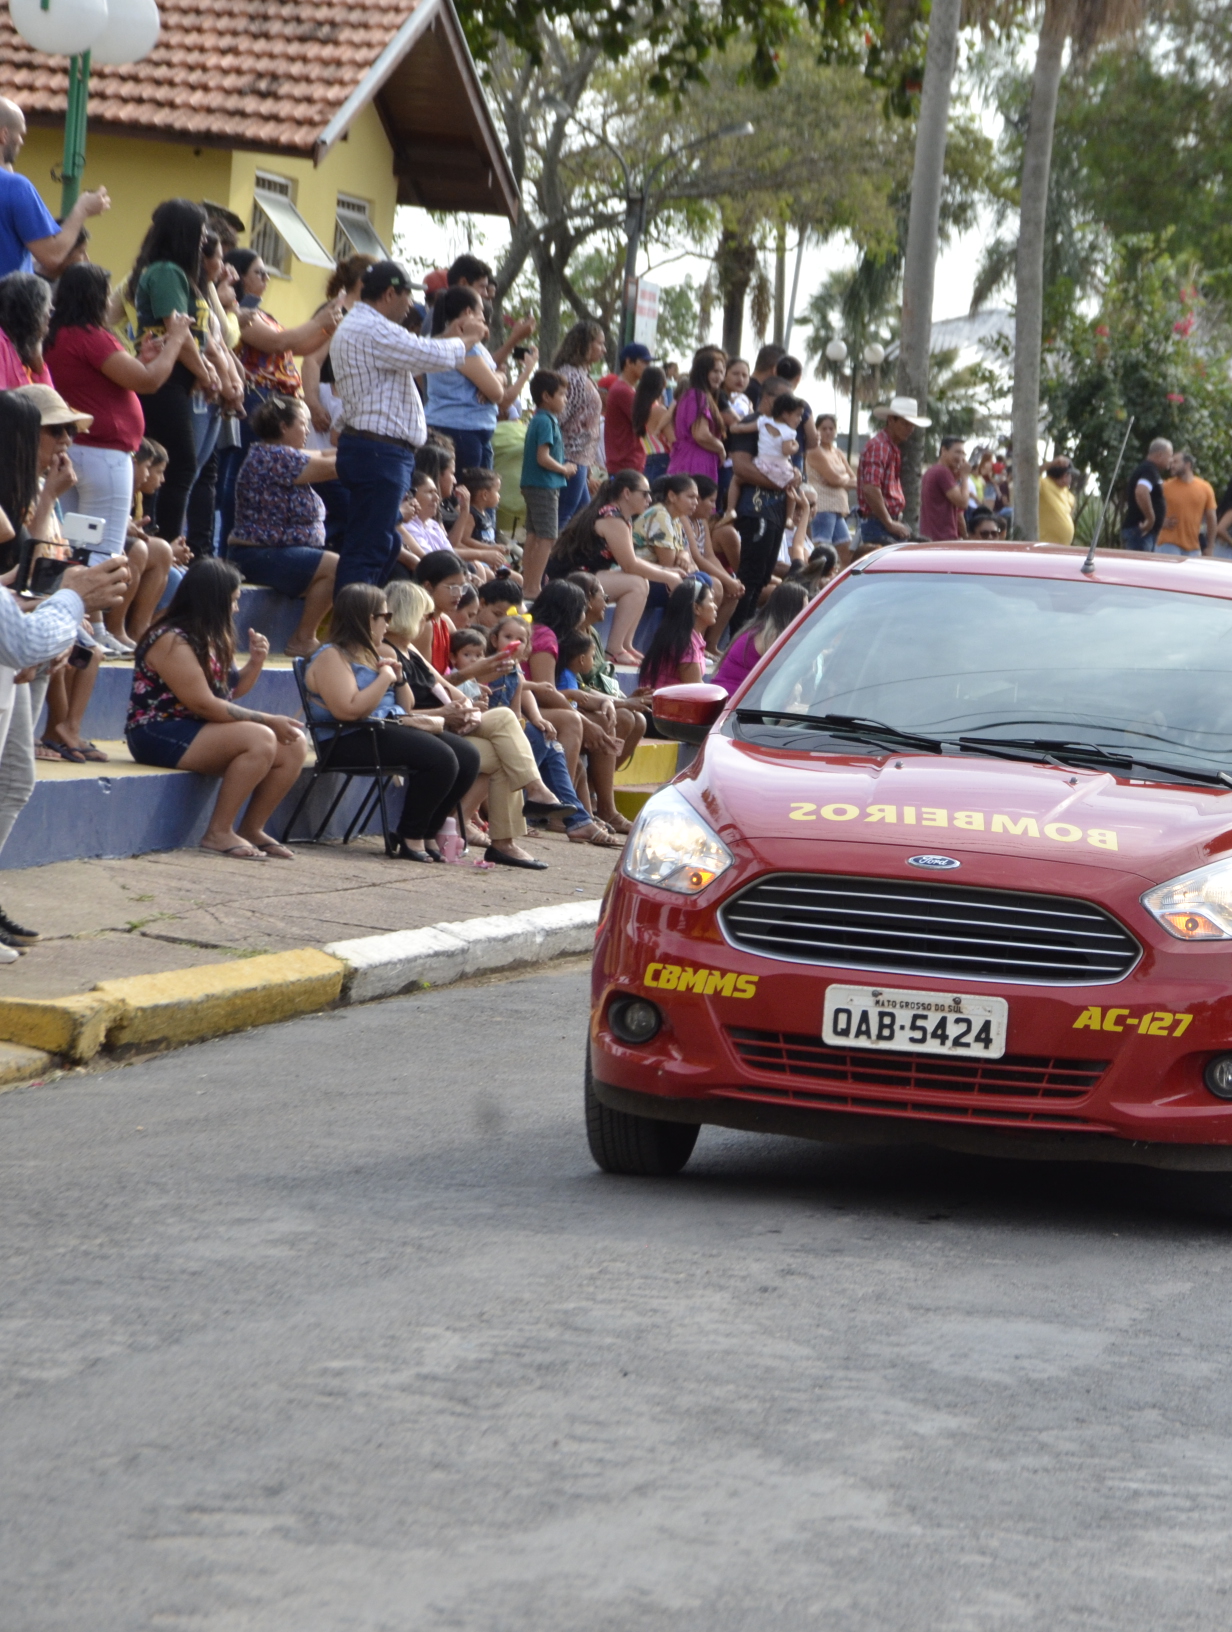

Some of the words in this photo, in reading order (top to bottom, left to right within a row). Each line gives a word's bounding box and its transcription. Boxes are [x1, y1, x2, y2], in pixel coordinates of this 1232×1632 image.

[918, 856, 949, 866] Ford
[643, 962, 760, 999] CBMMS
[875, 999, 897, 1008] MATO
[900, 1000, 932, 1011] GROSSO
[934, 1003, 946, 1012] DO
[947, 1004, 964, 1014] SUL
[1072, 1005, 1194, 1037] AC-127
